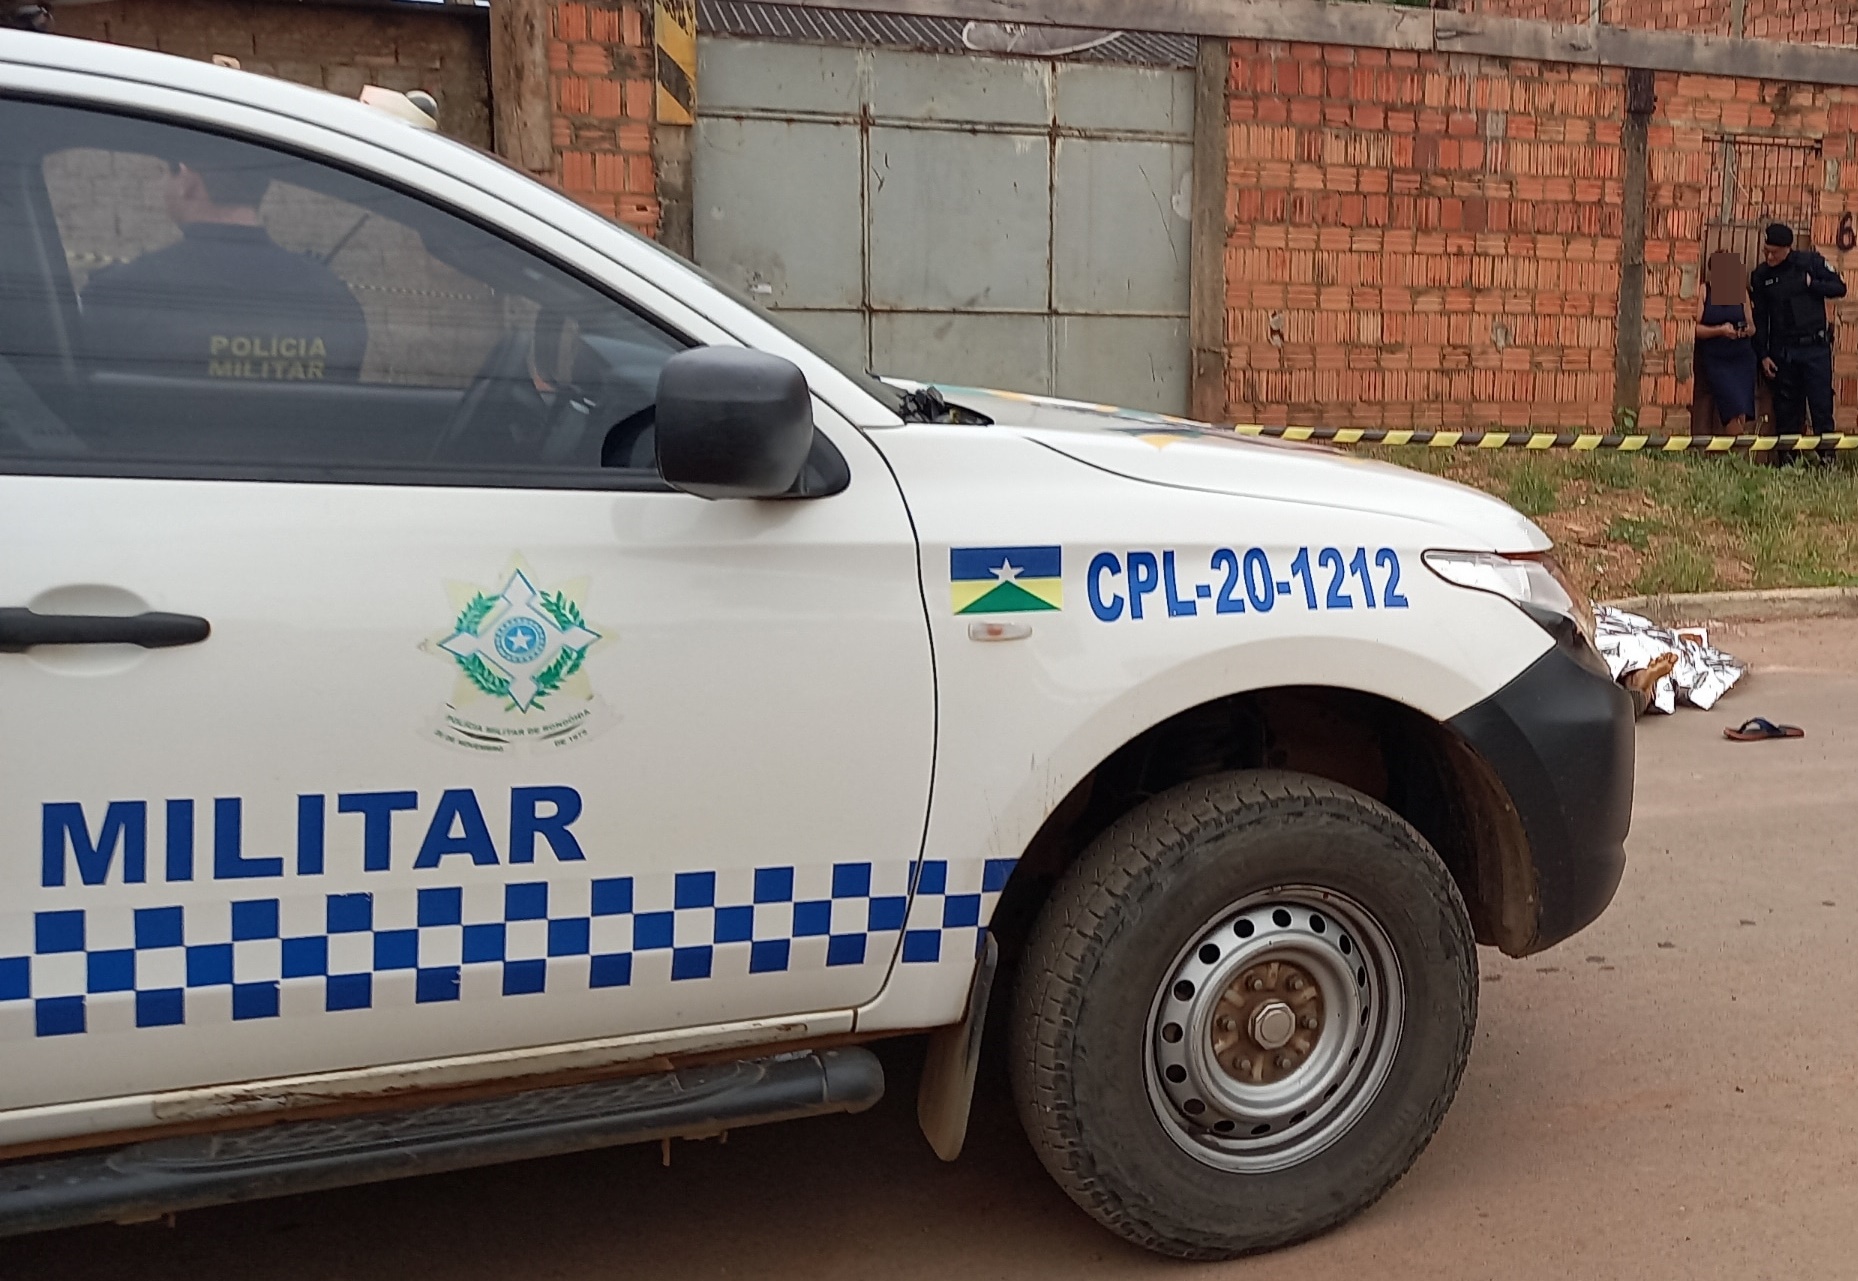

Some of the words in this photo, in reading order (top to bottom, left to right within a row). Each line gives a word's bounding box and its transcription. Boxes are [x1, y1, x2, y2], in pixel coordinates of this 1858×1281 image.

[1836, 211, 1857, 252] 6
[208, 358, 325, 380] MILITAR
[1087, 546, 1409, 622] CPL-20-1212
[41, 785, 587, 888] MILITAR
